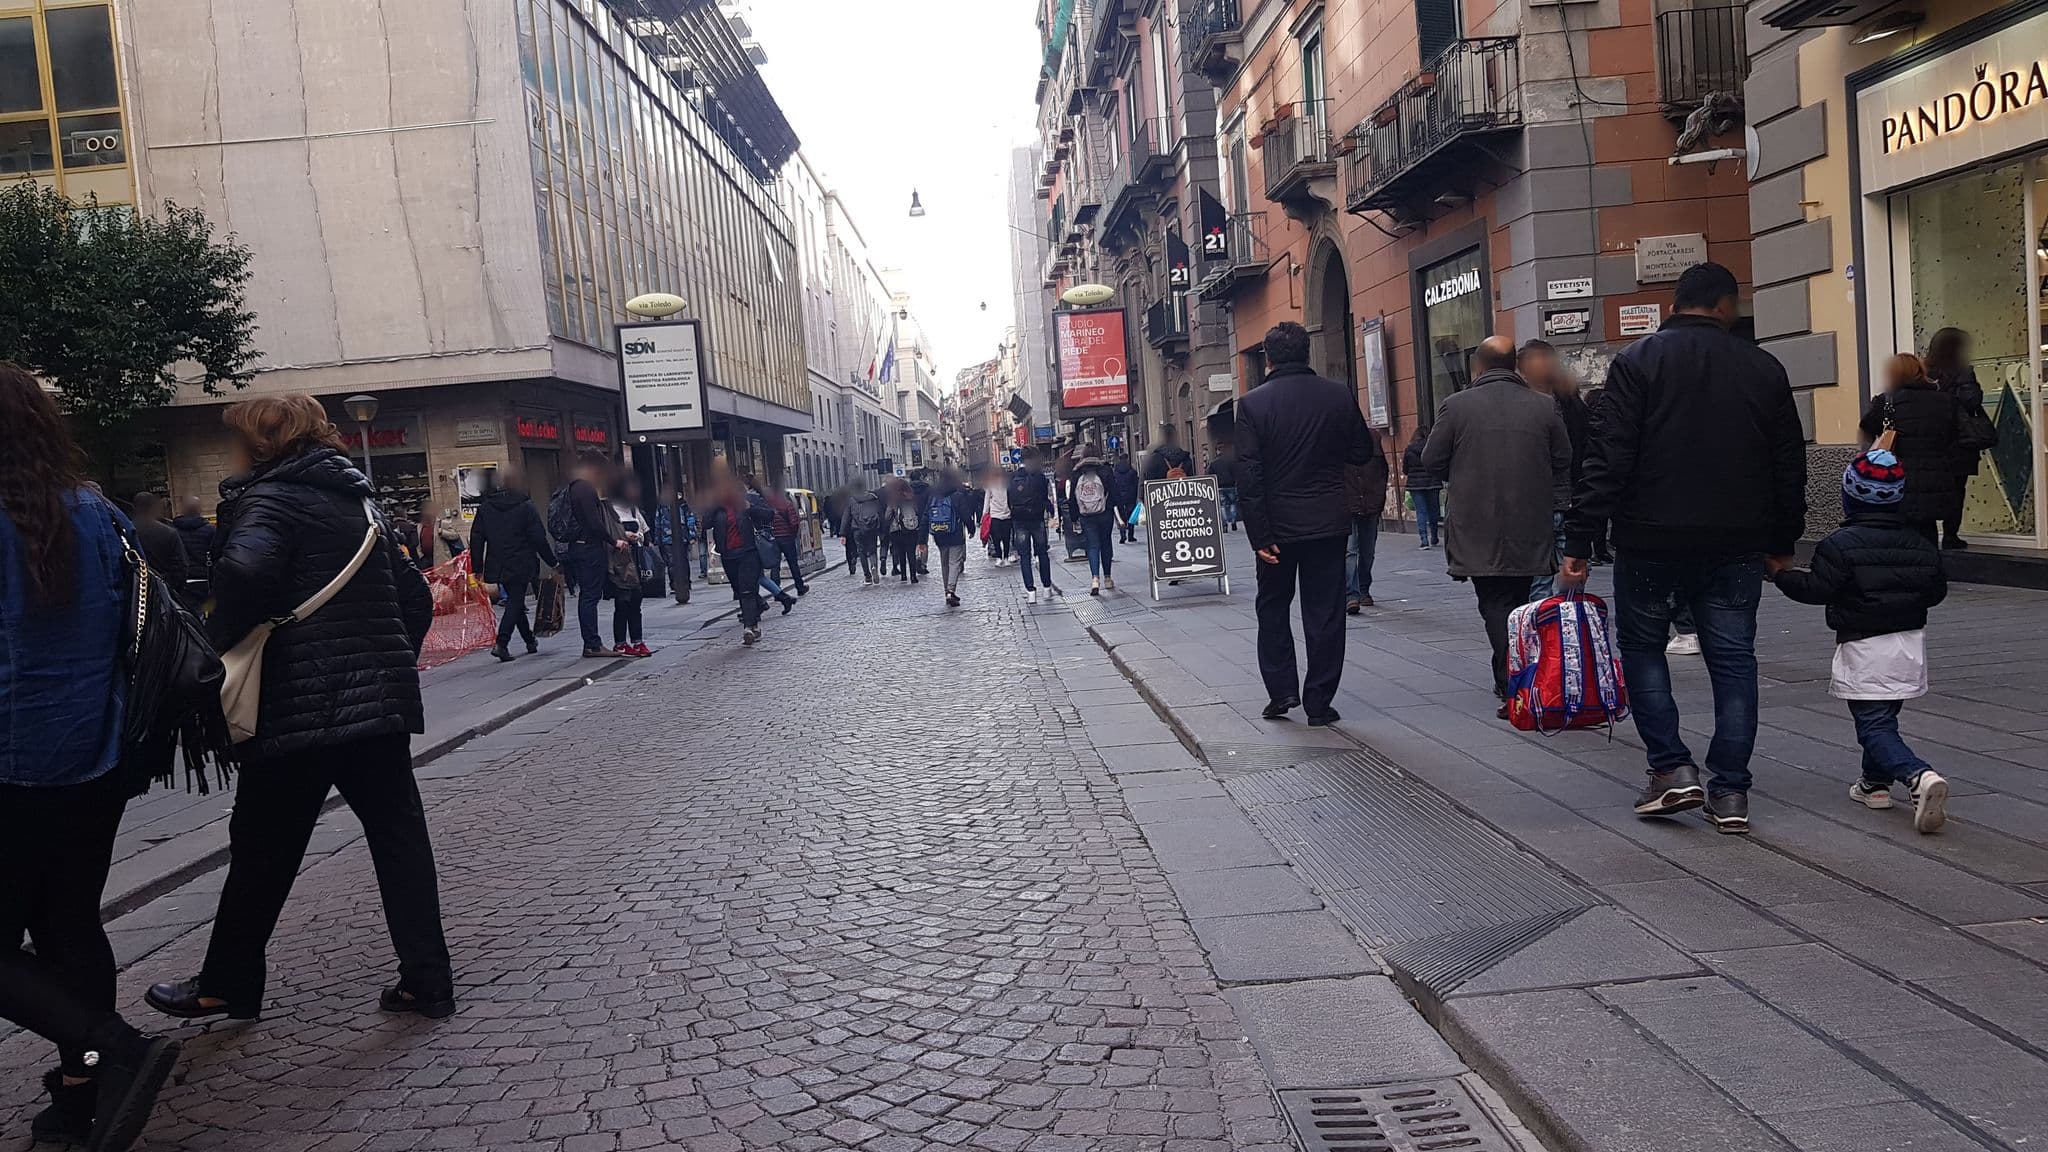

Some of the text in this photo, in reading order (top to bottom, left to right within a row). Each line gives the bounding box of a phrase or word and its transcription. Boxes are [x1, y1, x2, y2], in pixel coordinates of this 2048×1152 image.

[1882, 61, 2048, 154] PANDORA
[1204, 233, 1225, 249] 21
[1170, 267, 1189, 282] 21
[1424, 270, 1481, 308] CALZEDONIA
[1549, 281, 1591, 290] ESTETISTA
[650, 301, 672, 309] Toledo
[1060, 319, 1094, 330] STUDIO
[1060, 327, 1105, 338] MARINEO
[624, 341, 656, 355] SDN
[1061, 336, 1106, 348] CURA DEL
[1062, 346, 1089, 356] PIEDE
[1150, 481, 1215, 507] PRANZO FISSO
[1166, 507, 1196, 518] PRIMO
[1159, 517, 1213, 530] SECONDO +
[1160, 526, 1213, 540] CONTORNO
[1161, 541, 1215, 563] € 8,00
